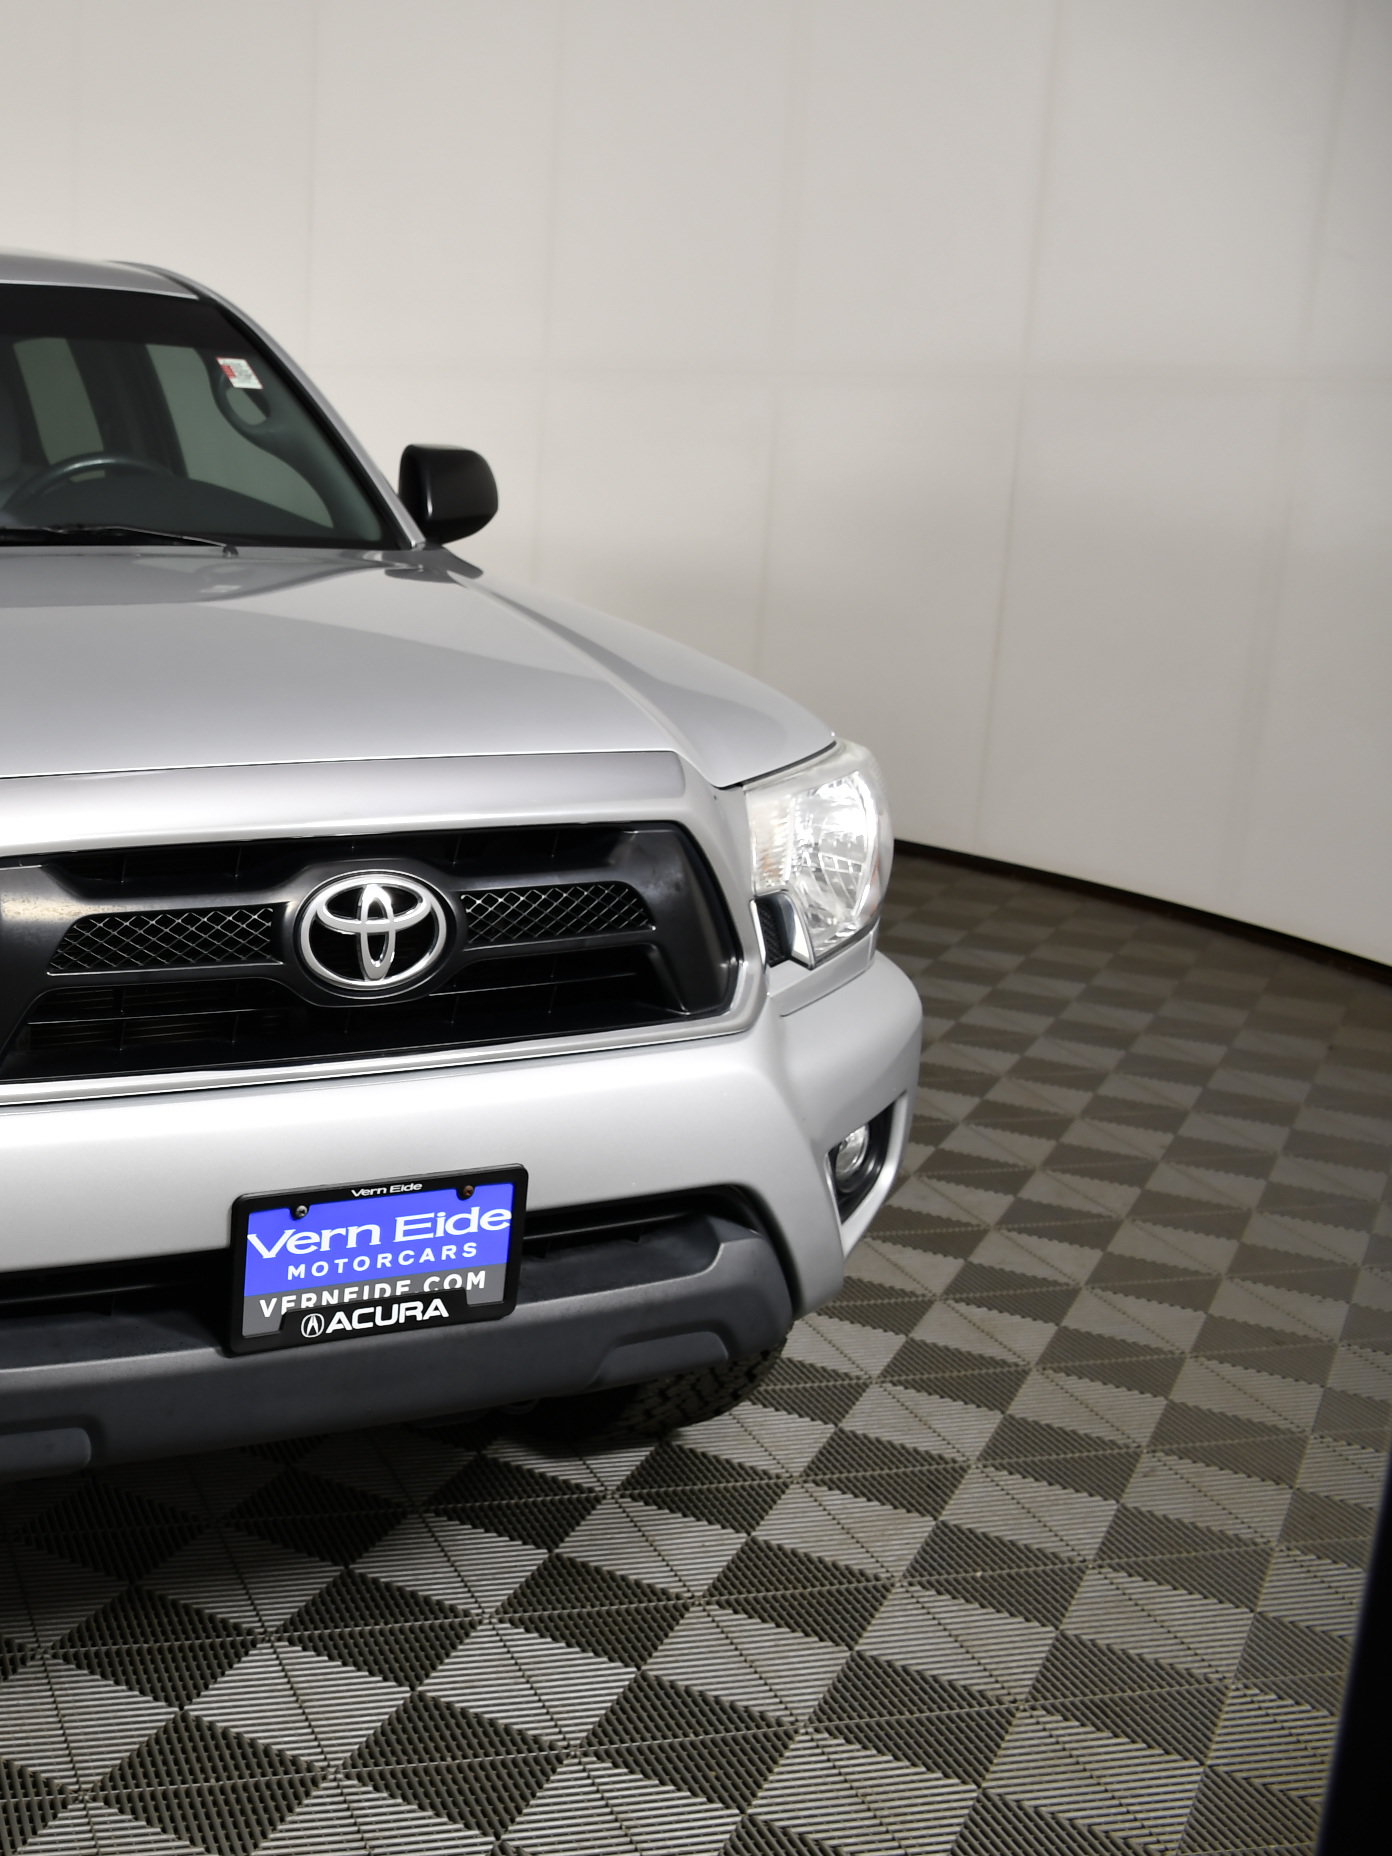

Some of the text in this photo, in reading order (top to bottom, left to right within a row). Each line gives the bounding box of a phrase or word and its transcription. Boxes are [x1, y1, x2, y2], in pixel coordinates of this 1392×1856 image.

[351, 1182, 423, 1198] Vern Eide
[246, 1206, 512, 1259] Vern Eide
[287, 1242, 478, 1281] MOTORCARS
[259, 1270, 487, 1318] VERNEIDECOM
[325, 1298, 450, 1334] ACURA
